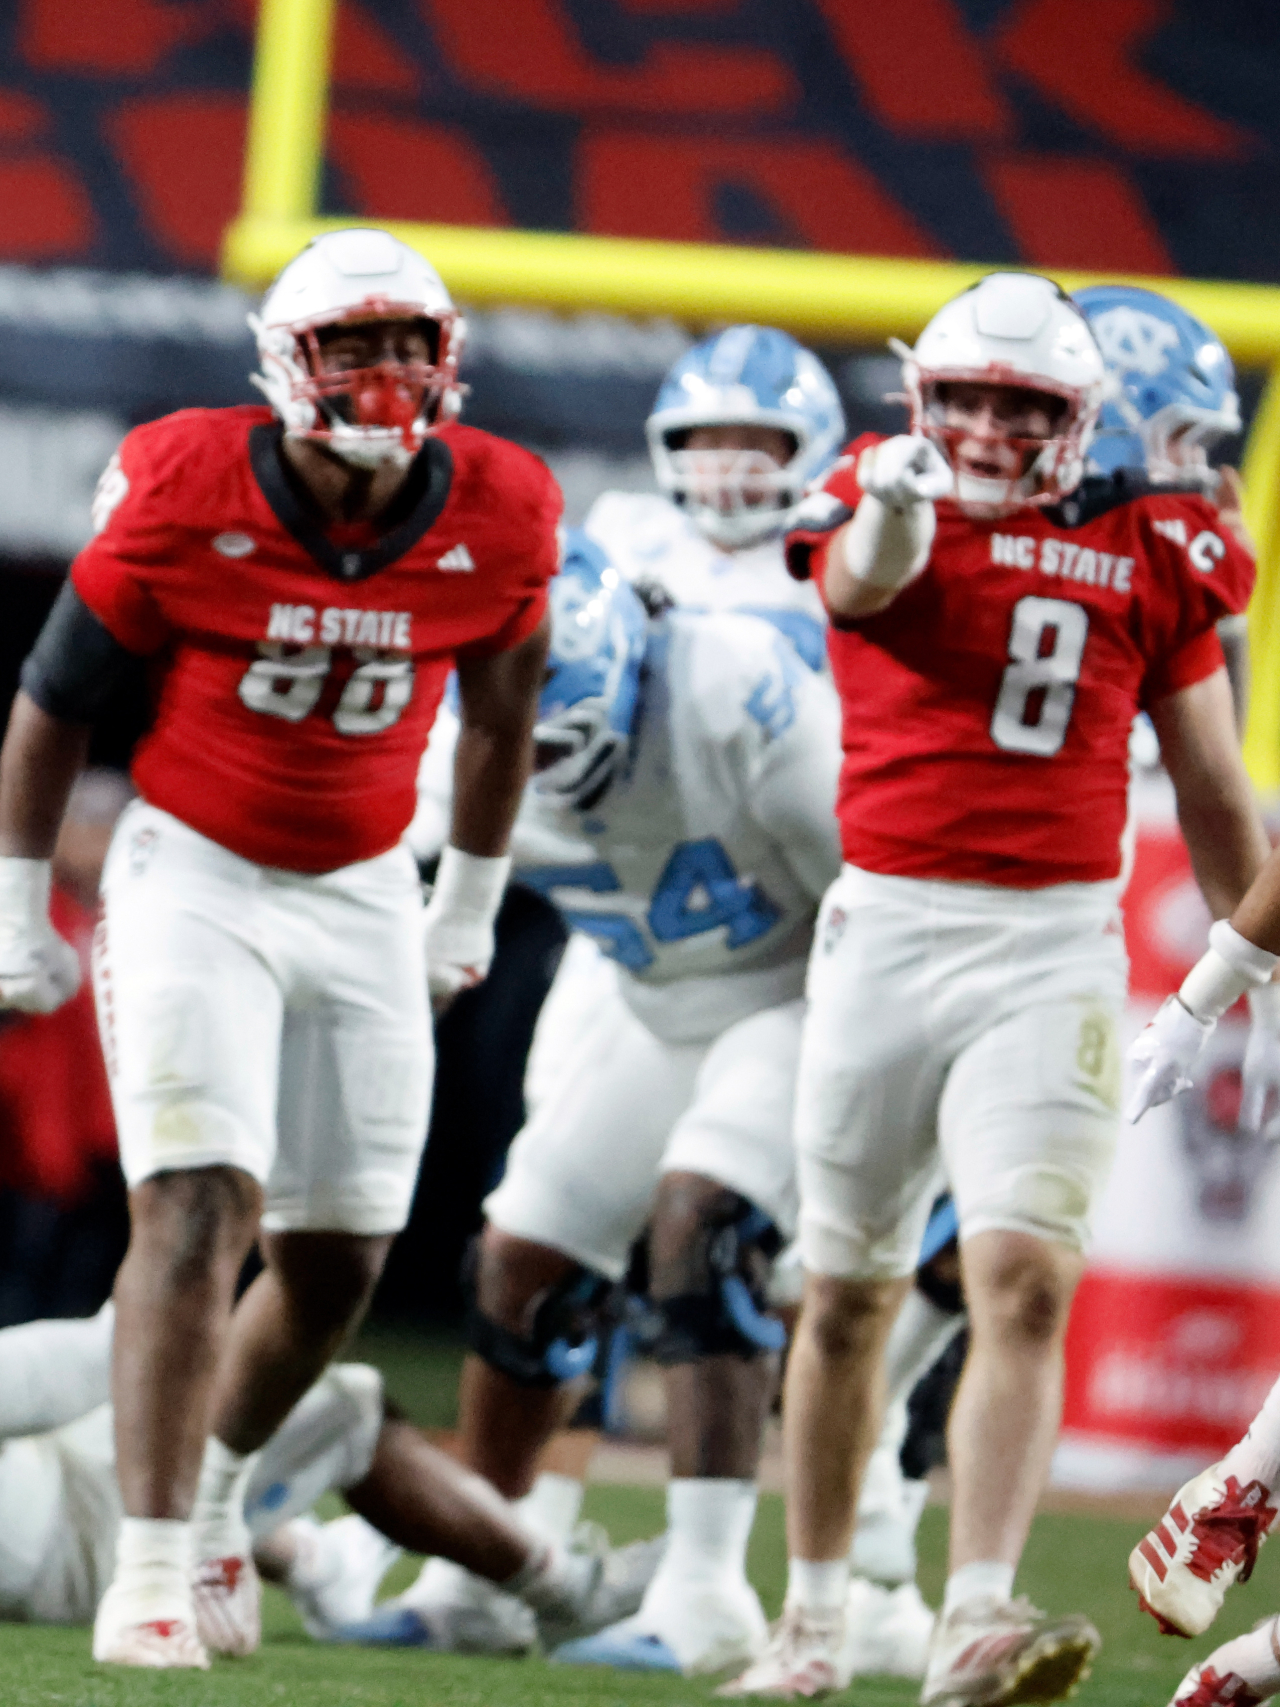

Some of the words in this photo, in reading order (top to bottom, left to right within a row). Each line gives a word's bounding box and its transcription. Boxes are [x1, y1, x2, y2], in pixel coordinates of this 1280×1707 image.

[990, 532, 1036, 570] NC
[1038, 537, 1135, 594] STATE
[1187, 529, 1226, 573] C
[267, 602, 316, 641] NC
[319, 606, 413, 648] STATE
[989, 595, 1088, 758] 8
